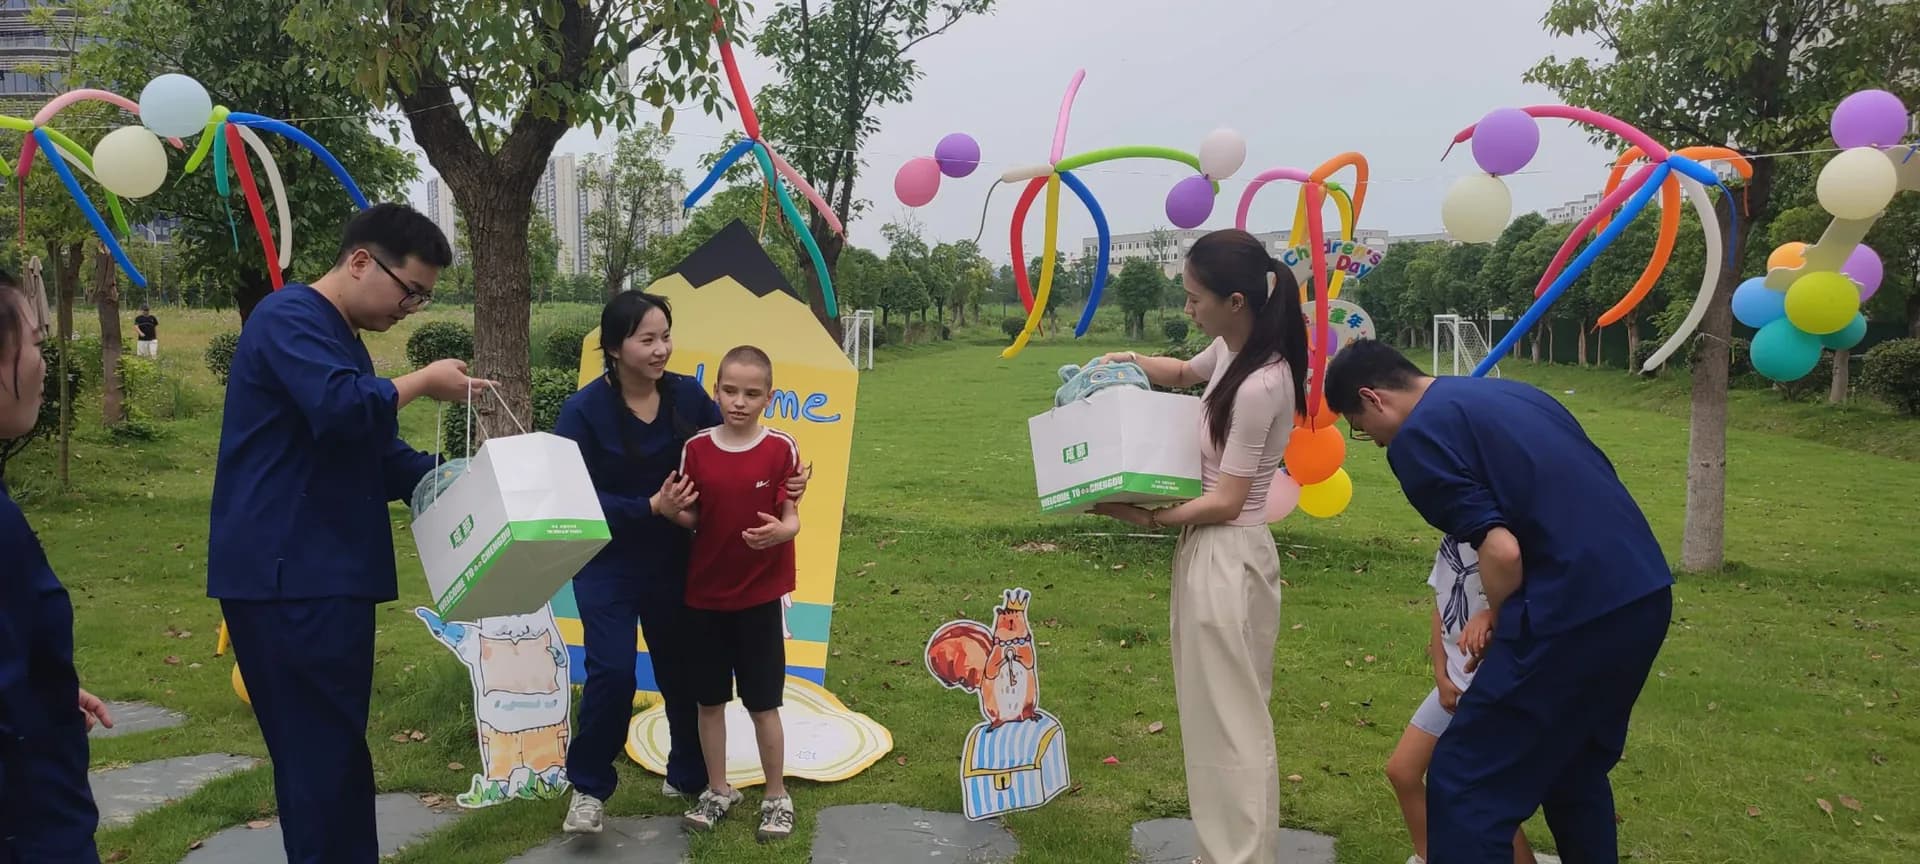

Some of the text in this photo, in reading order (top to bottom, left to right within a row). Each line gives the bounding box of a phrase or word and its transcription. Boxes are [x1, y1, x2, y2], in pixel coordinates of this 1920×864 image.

[1283, 238, 1382, 267] Chdren's
[1336, 254, 1372, 279] Day
[1040, 490, 1071, 508] WELCOME
[1071, 487, 1081, 498] TO
[1089, 475, 1124, 493] CHENGDU
[438, 526, 512, 613] WELCOME TO CHENGDU
